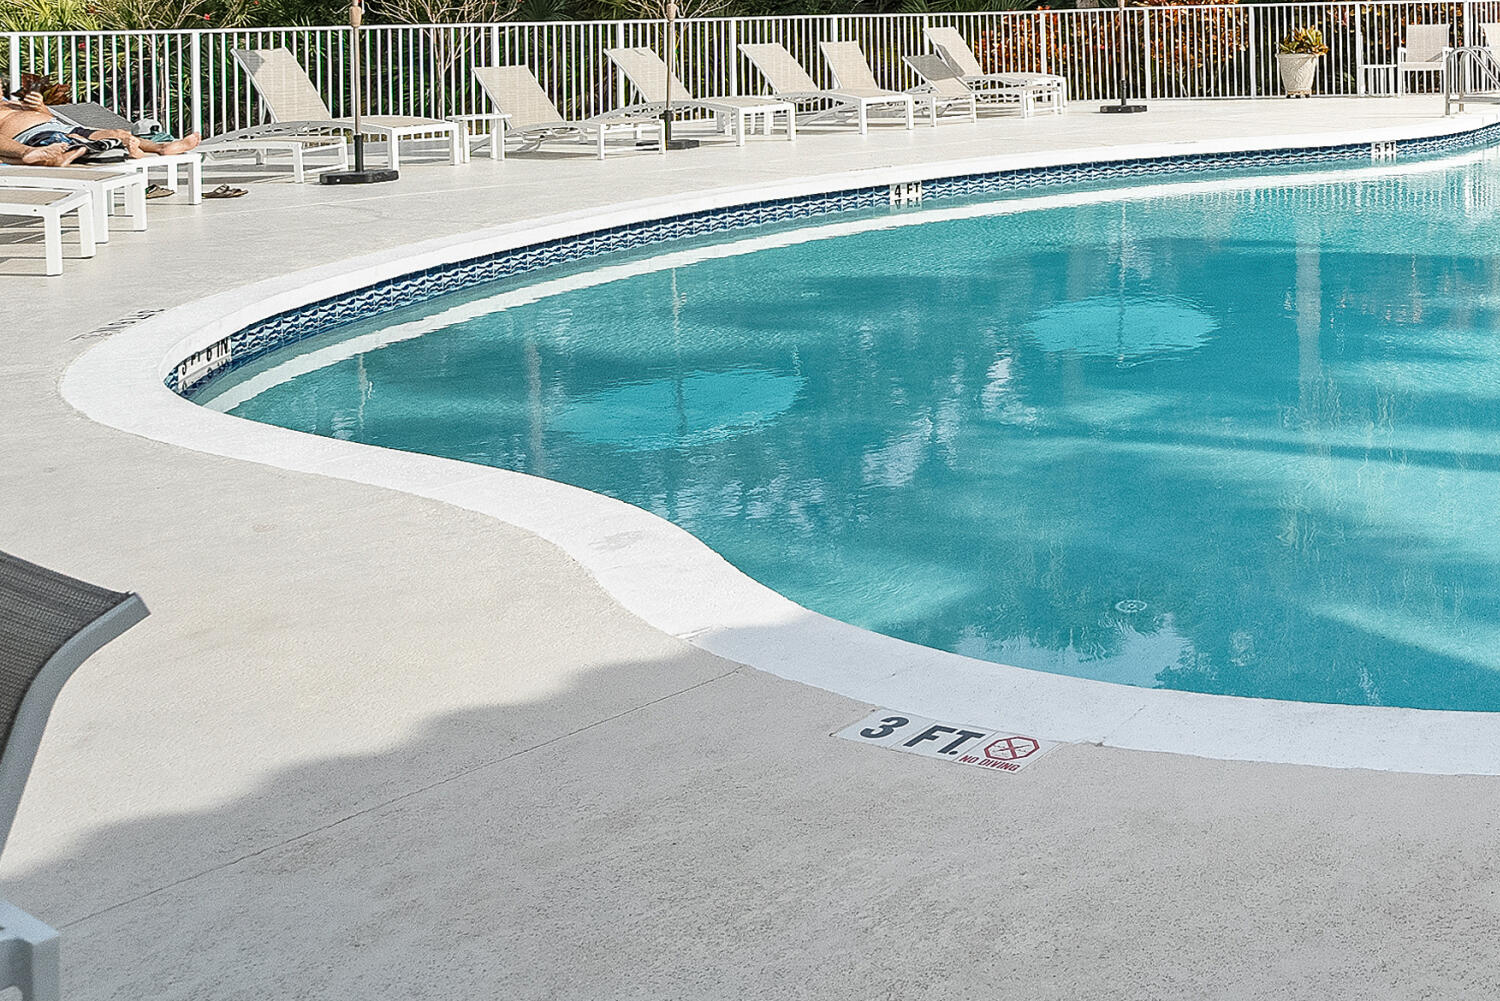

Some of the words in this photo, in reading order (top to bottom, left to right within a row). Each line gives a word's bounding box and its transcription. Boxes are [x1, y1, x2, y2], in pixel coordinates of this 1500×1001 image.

[1374, 143, 1381, 152] 5
[1384, 141, 1395, 152] FT
[894, 184, 901, 198] 4
[907, 182, 920, 195] FT
[860, 716, 910, 739] 3
[903, 724, 986, 756] FT.
[958, 755, 980, 763] NO
[977, 758, 1020, 772] DIVING
